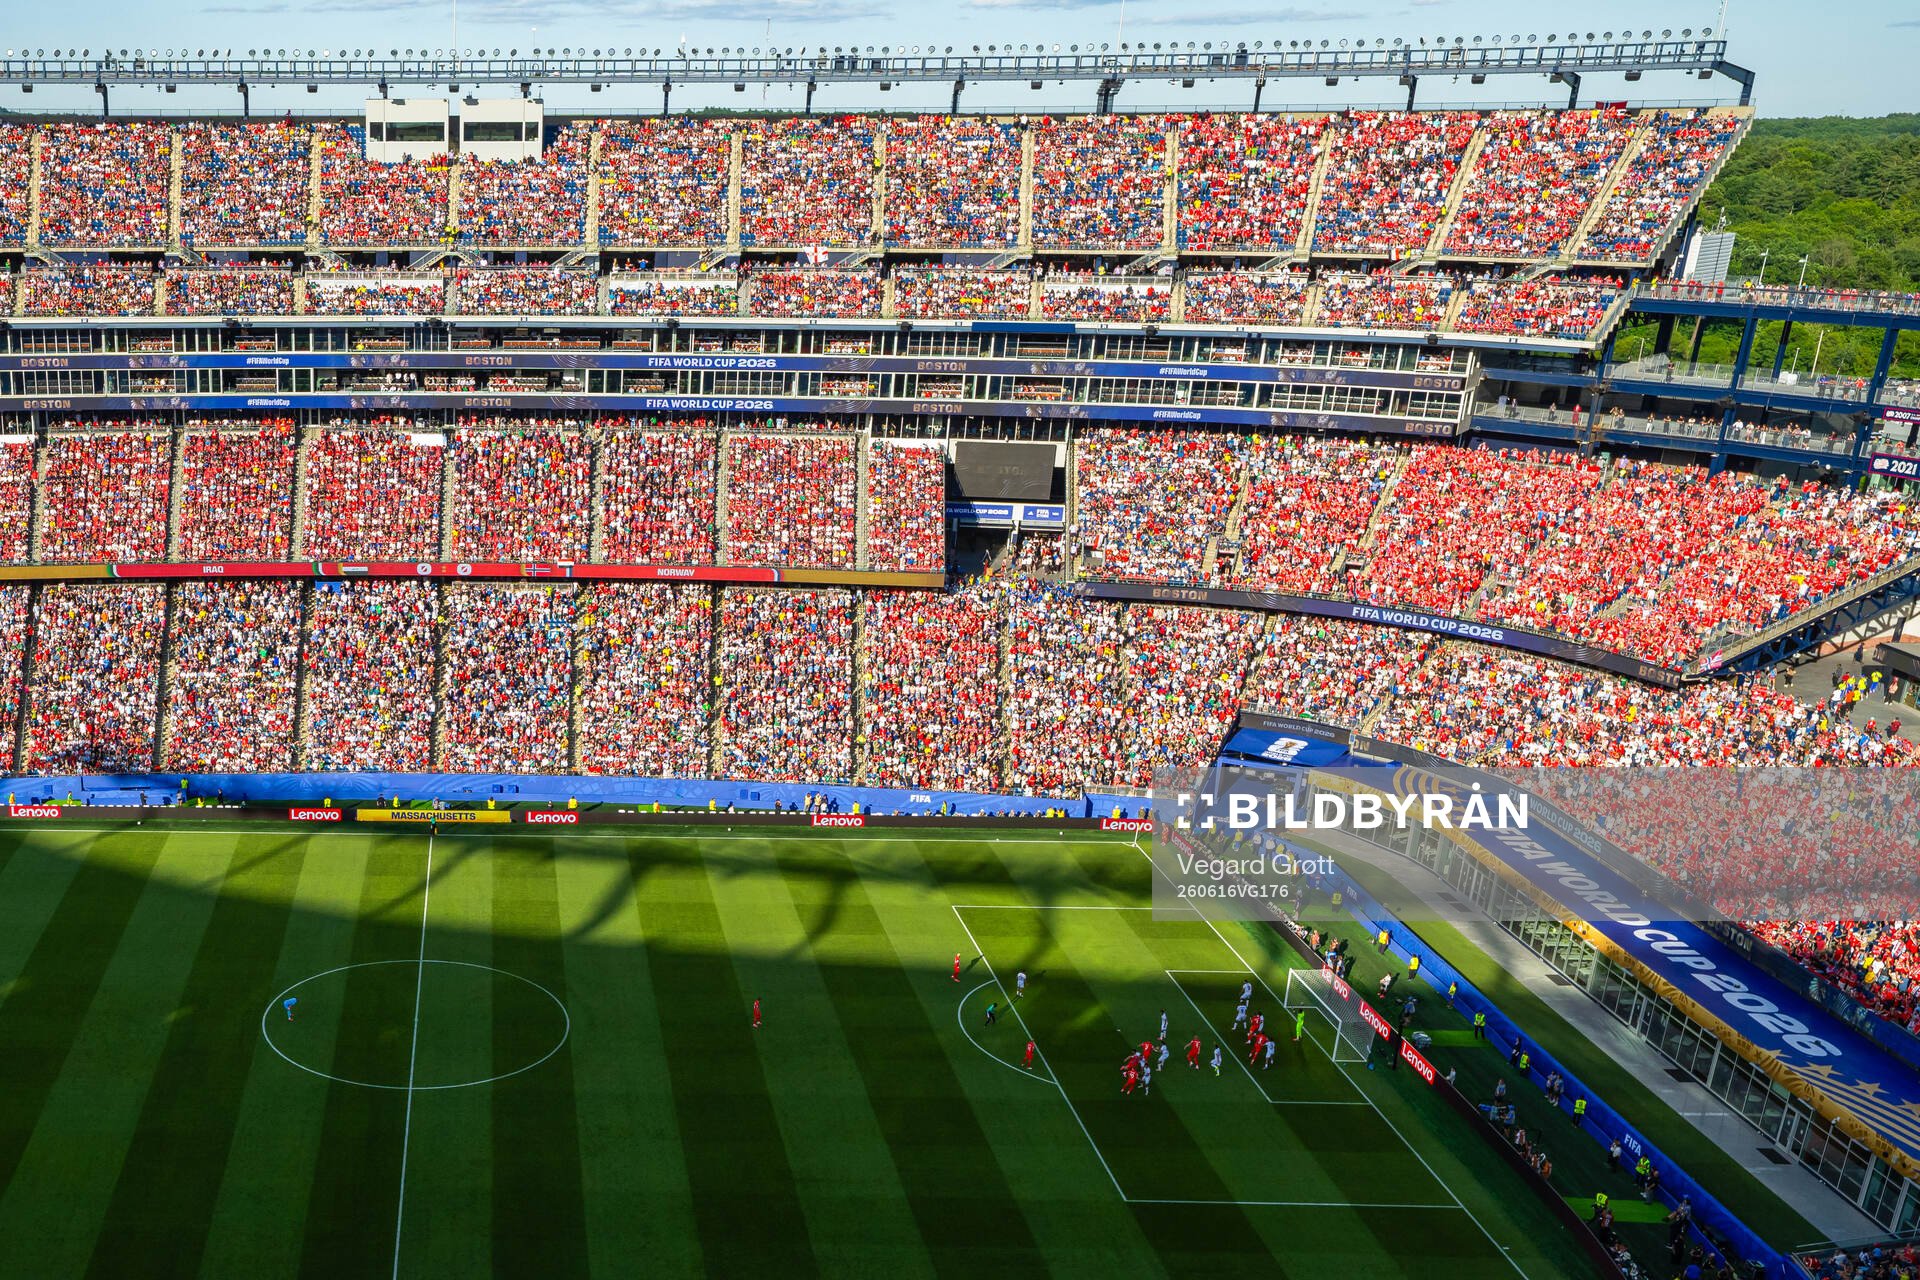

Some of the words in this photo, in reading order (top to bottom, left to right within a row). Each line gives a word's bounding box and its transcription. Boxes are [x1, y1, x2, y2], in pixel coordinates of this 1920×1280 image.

[21, 358, 68, 367] BOSTON
[246, 357, 290, 366] #FIFAWorldCup
[465, 356, 512, 365] BOSTON
[648, 358, 671, 367] FIFA
[672, 358, 712, 367] WORLD
[714, 358, 737, 368] CUP
[738, 358, 776, 368] 2026
[917, 361, 967, 371] BOSTON
[1159, 367, 1208, 376] #FIFAWorldCup
[23, 400, 71, 409] BOSTON
[247, 398, 290, 407] #FIFAWorldCup
[465, 398, 512, 407] BOSTON
[646, 399, 669, 408] FIFA
[670, 399, 710, 409] WORLD
[711, 400, 734, 409] CUP
[735, 400, 773, 410] 2026
[913, 403, 962, 413] BOSTON
[1153, 410, 1201, 419] #FIFAWorldCup
[1894, 411, 1911, 420] 2007
[1890, 460, 1918, 475] 2021
[1152, 588, 1208, 600] BOSTON
[1352, 606, 1380, 620] FIFA
[1382, 610, 1429, 627] WORLD
[1430, 617, 1457, 632] CUP
[1458, 623, 1504, 641] 2026
[1263, 720, 1277, 728] FIFA
[1278, 722, 1300, 731] WORLD
[1302, 725, 1314, 733] CUP
[910, 794, 932, 804] FIFA
[11, 806, 58, 818] Lenovo
[292, 809, 339, 820] Lenovo
[391, 811, 476, 820] MASSACHUSETTS
[528, 812, 576, 823] Lenovo
[813, 815, 862, 826] Lenovo
[1102, 818, 1152, 831] Lenovo
[1530, 797, 1557, 824] WORLD
[1558, 817, 1574, 834] CUP
[1572, 828, 1602, 853] 2026
[1708, 914, 1752, 952] BOSTON
[1484, 827, 1555, 860] FIFA
[1536, 861, 1650, 926] WORLD
[1633, 929, 1716, 971] CUP
[1692, 973, 1842, 1057] 2026
[1360, 1002, 1389, 1038] Lenovo
[1402, 1044, 1433, 1081] Lenovo
[1624, 1134, 1642, 1156] FIFA
